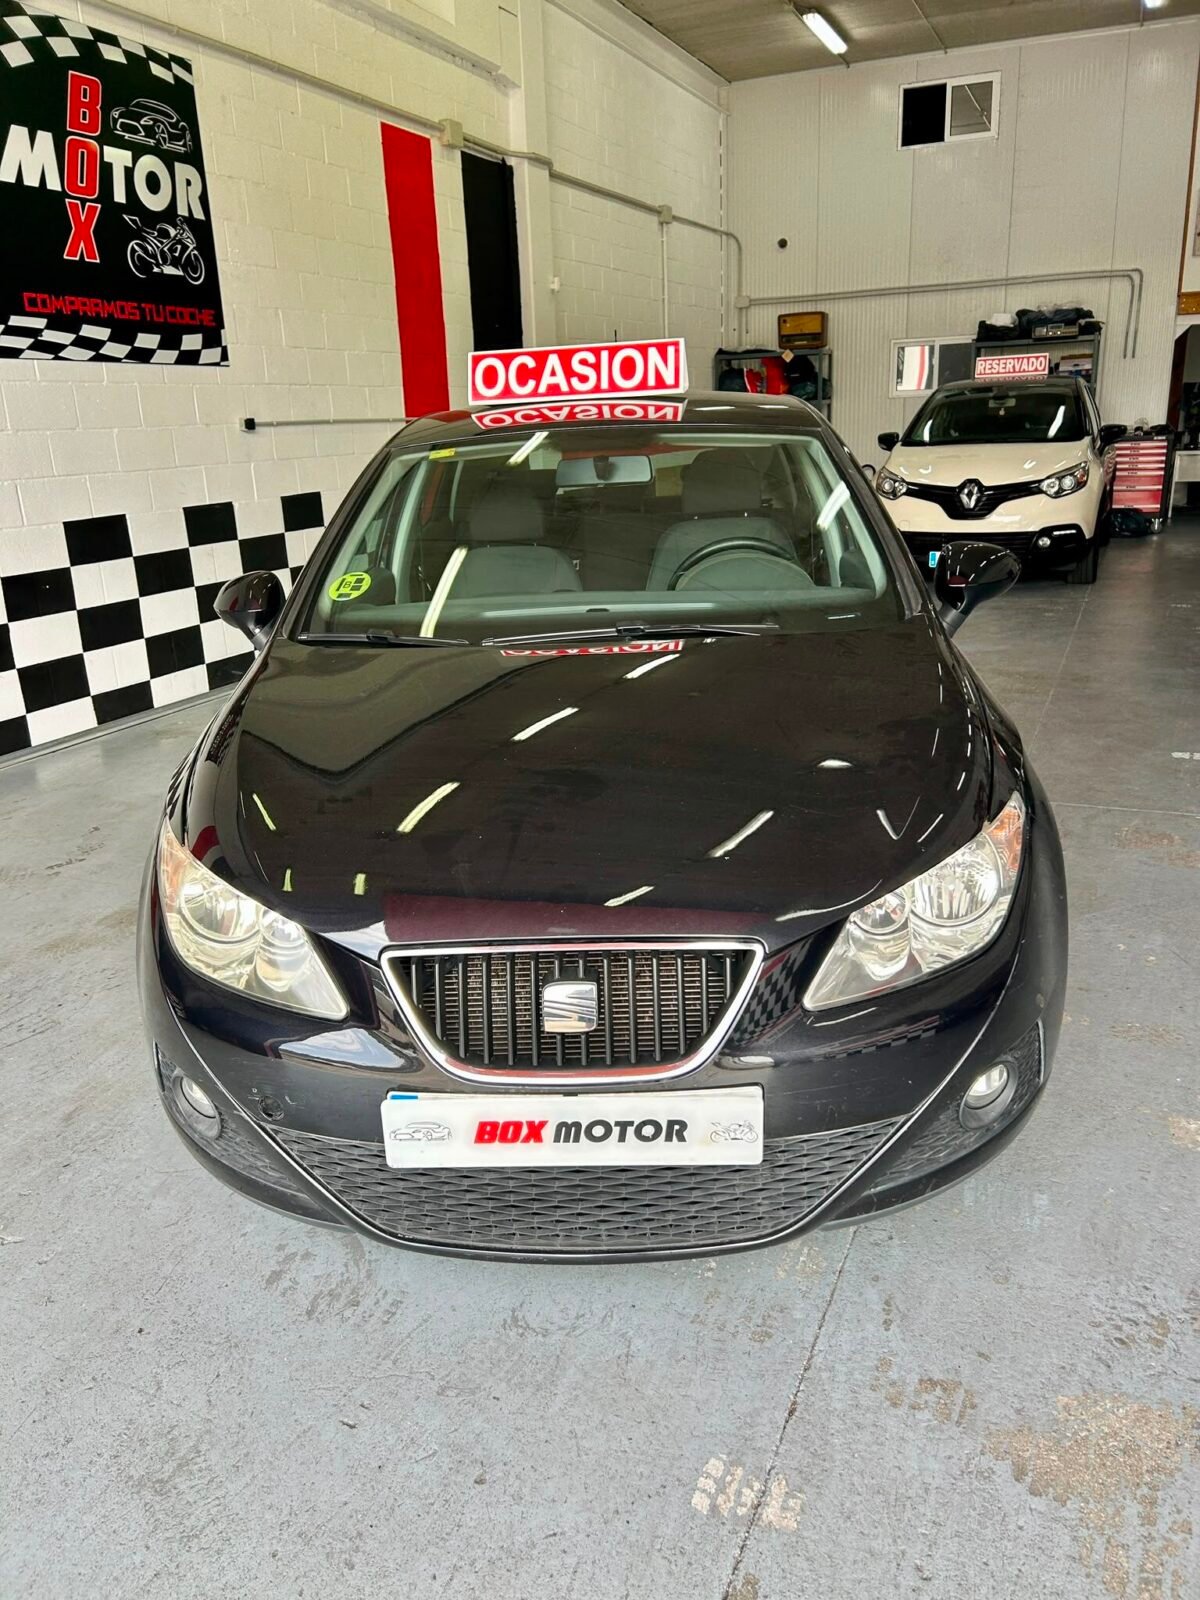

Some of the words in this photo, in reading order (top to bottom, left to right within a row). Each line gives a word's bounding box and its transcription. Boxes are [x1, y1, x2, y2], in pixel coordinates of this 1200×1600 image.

[63, 70, 102, 263] BOX
[23, 292, 140, 320] COMPRAMOS
[141, 303, 164, 322] TU
[166, 305, 216, 326] COCHE
[474, 345, 675, 397] OCASION
[977, 356, 1046, 374] RESERVADO
[473, 1119, 549, 1144] BOX
[552, 1119, 688, 1143] MOTOR
